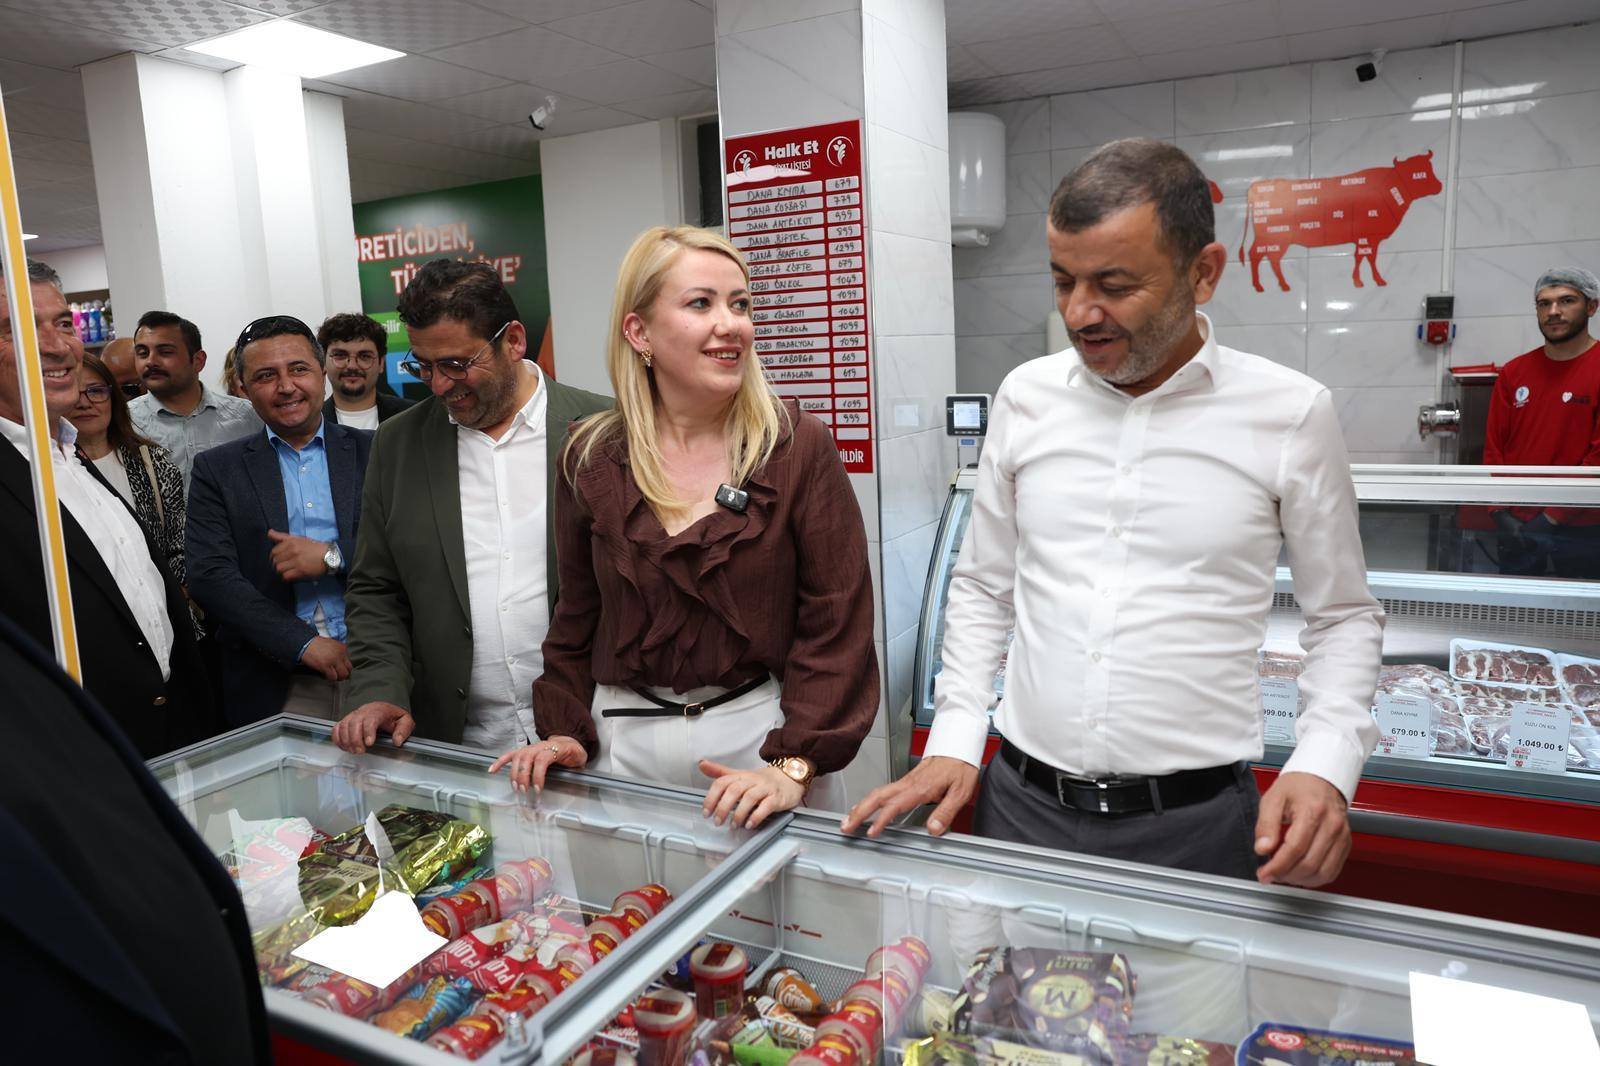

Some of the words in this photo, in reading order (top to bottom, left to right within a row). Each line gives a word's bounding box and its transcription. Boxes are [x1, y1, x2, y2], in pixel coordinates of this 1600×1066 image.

[765, 143, 801, 160] Halk
[803, 140, 819, 155] Et
[747, 189, 772, 200] DANA
[834, 178, 851, 186] 679
[747, 204, 770, 216] DANA
[833, 194, 851, 203] 779
[747, 222, 768, 231] DANA
[835, 209, 853, 221] 999
[748, 236, 770, 246] DANA
[836, 224, 853, 236] 899
[750, 250, 771, 261] DANA
[834, 242, 855, 252] 1299
[838, 259, 853, 267] 679
[836, 274, 857, 285] 1049
[774, 294, 794, 304] BUT
[837, 290, 857, 299] 1099
[838, 306, 860, 315] 1049
[838, 321, 858, 331] 1099
[840, 337, 859, 346] 1099
[841, 352, 856, 361] 669
[842, 399, 862, 408] 1099
[843, 413, 860, 423] 999
[1391, 727, 1418, 737] 679.00
